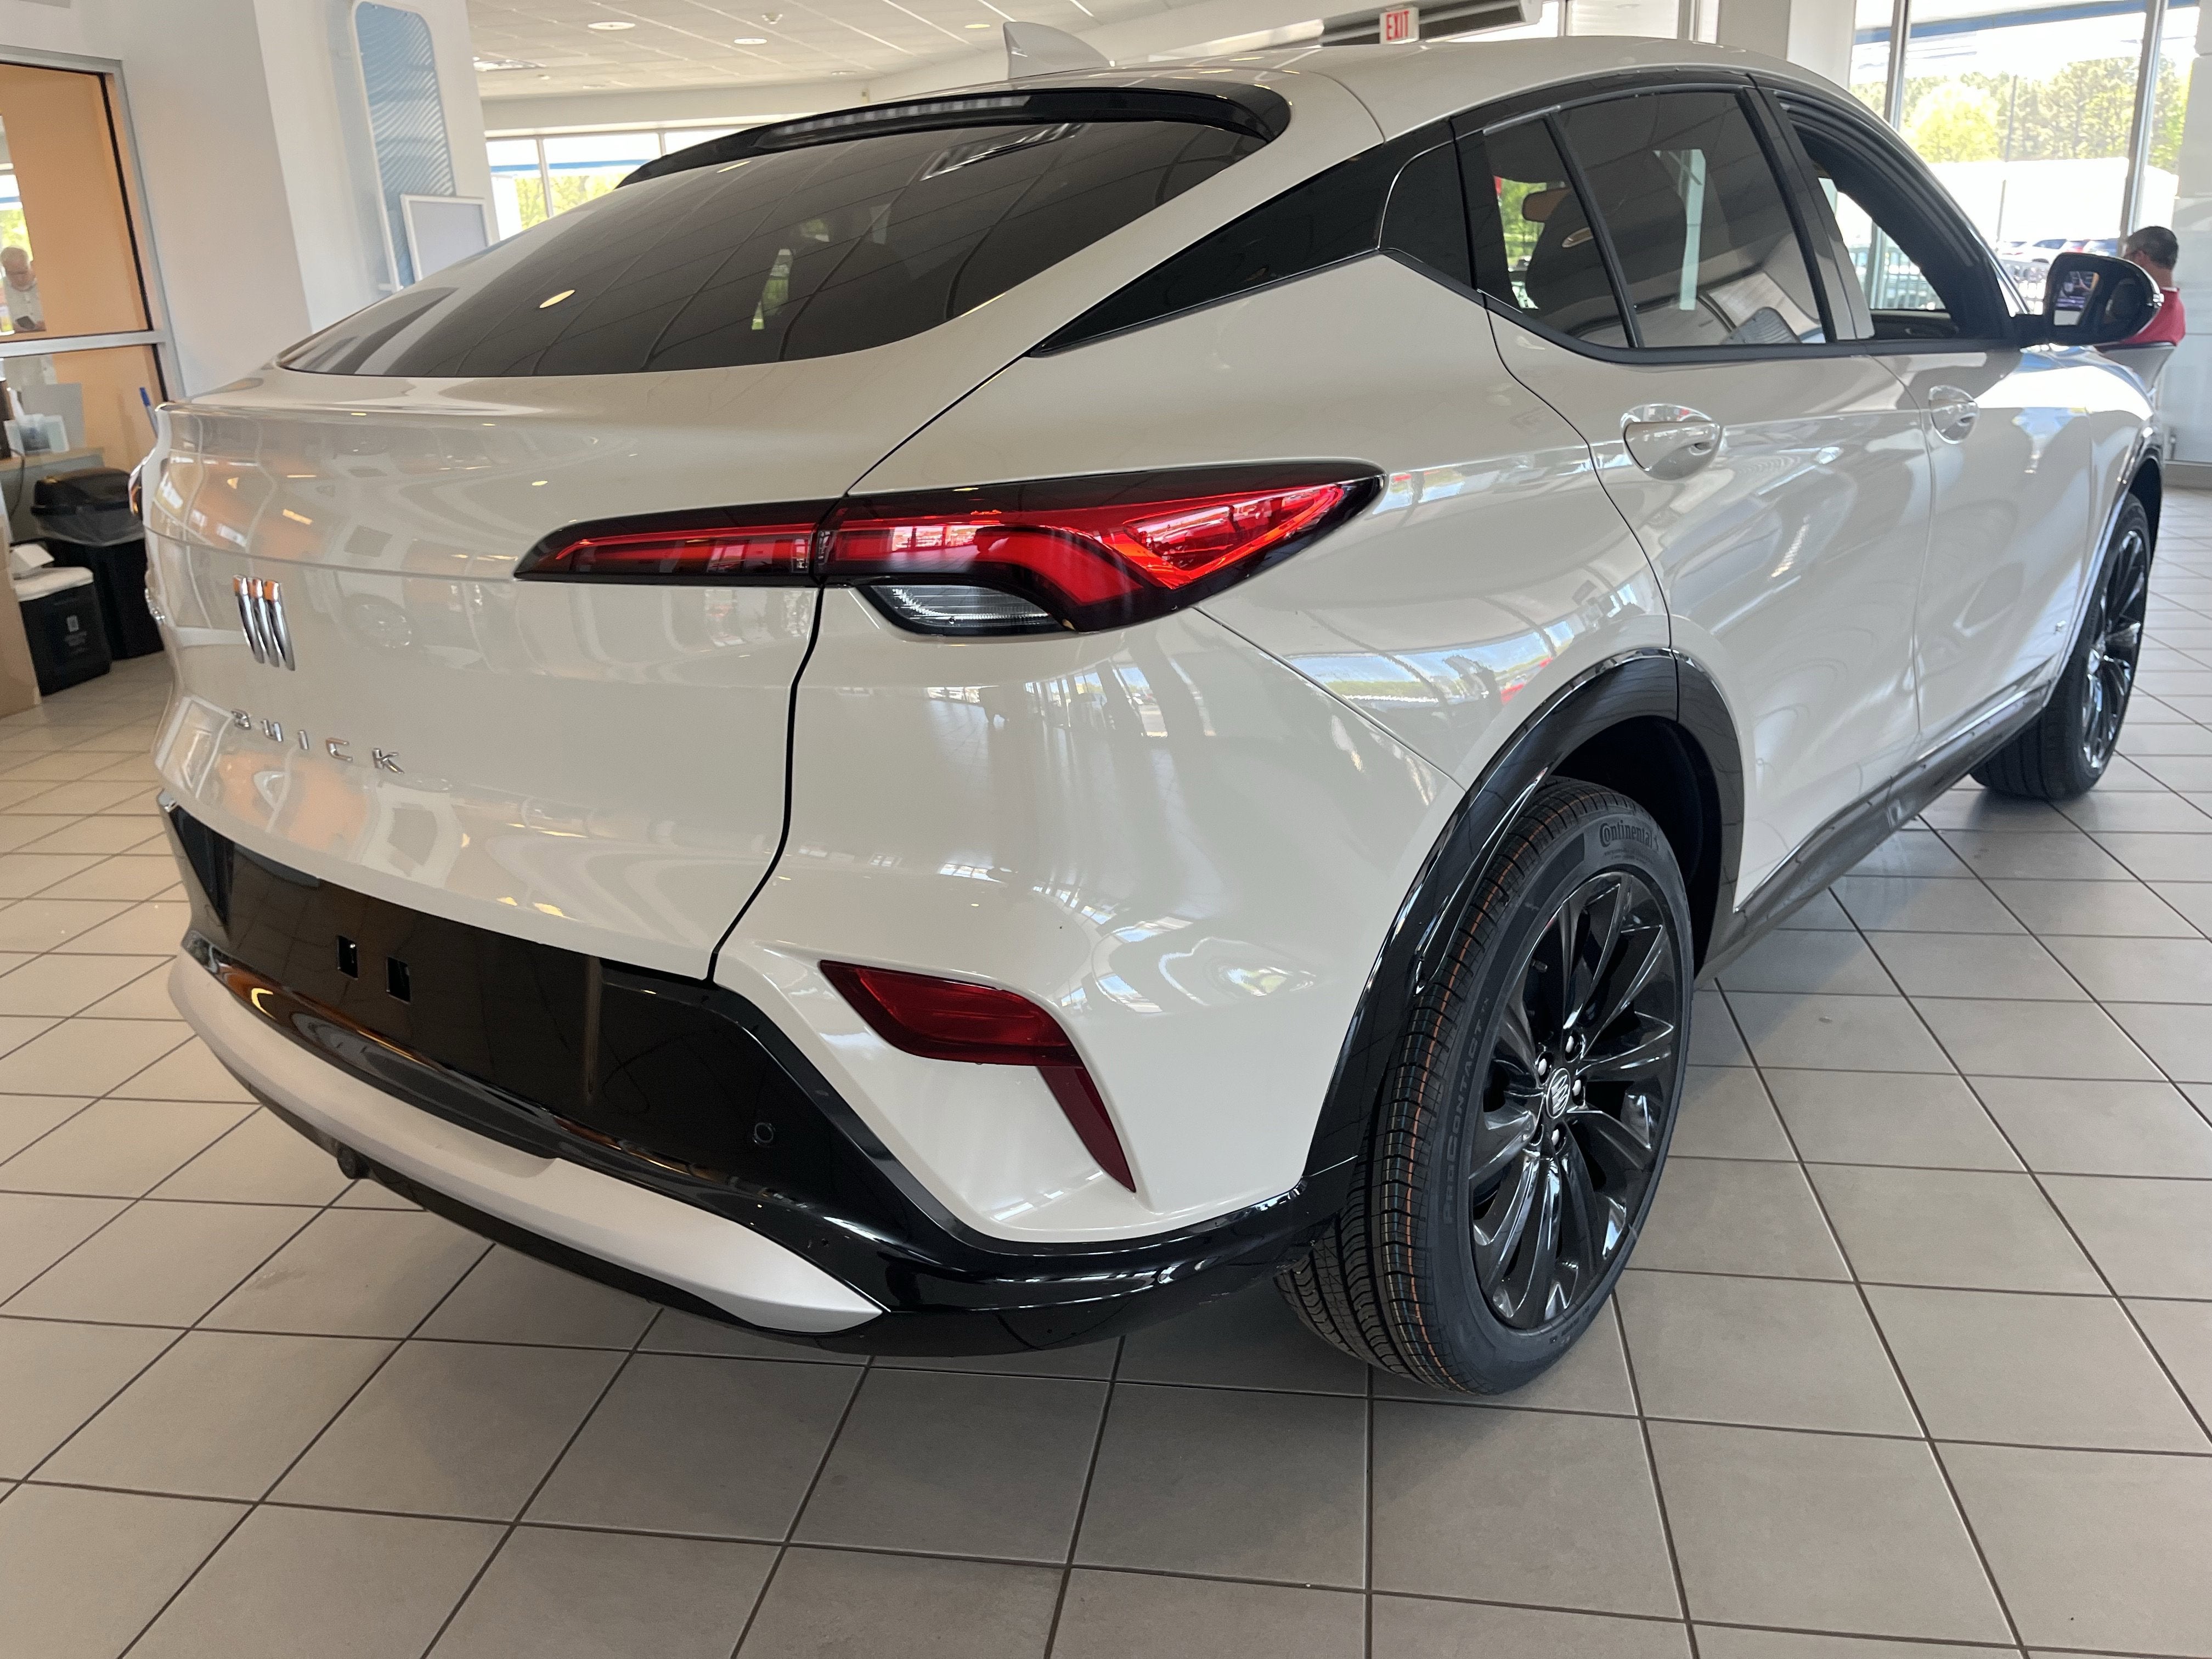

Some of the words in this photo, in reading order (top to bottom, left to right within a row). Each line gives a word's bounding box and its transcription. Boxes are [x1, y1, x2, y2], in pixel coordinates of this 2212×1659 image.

[1386, 10, 1409, 41] EXIT
[230, 708, 405, 775] BUICK
[1599, 819, 1653, 849] Continental
